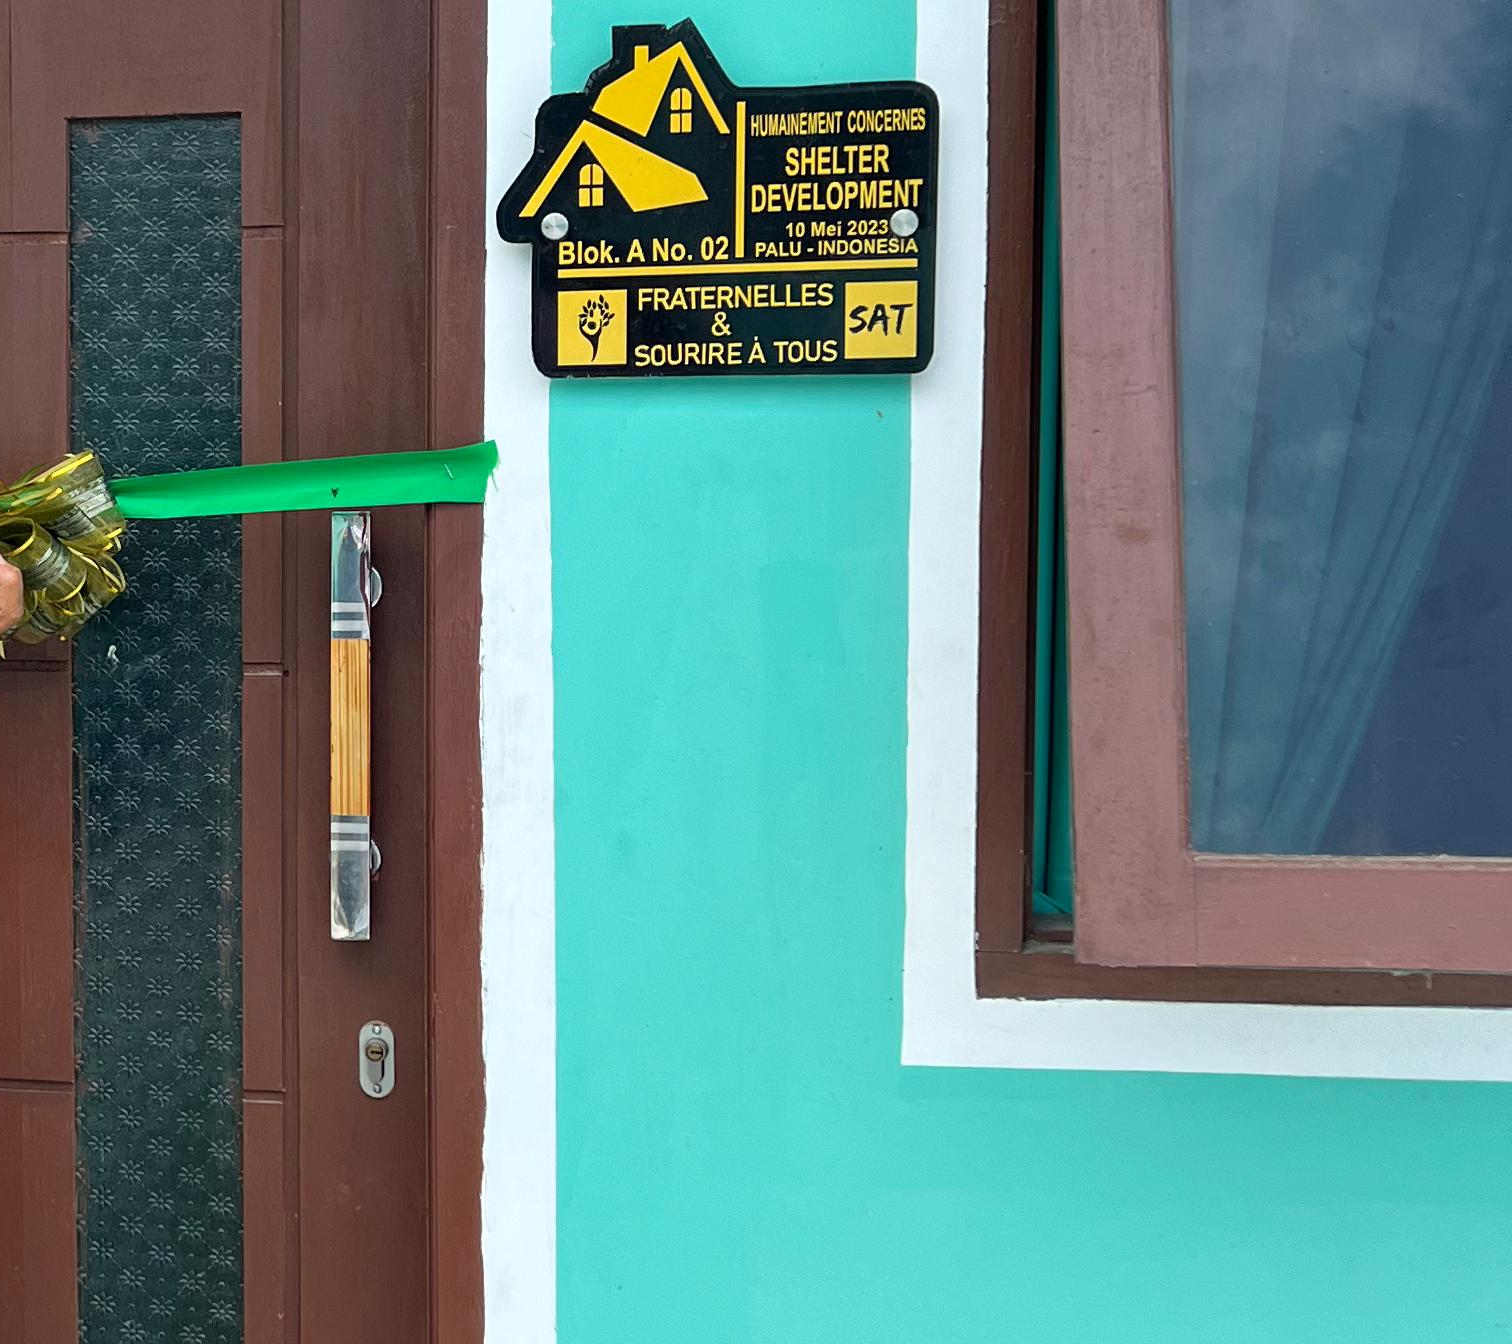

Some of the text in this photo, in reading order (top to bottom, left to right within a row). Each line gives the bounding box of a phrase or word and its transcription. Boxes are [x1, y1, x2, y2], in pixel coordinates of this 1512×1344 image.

[751, 108, 925, 136] HUMAINEMENT CONCERNES
[785, 145, 889, 176] SHELTER
[752, 179, 923, 210] DEVELOPMENT
[786, 219, 888, 237] 10 Mei 2023
[559, 236, 728, 265] Blok. A No. 02
[756, 241, 801, 257] PALU
[818, 238, 918, 255] INDONESIA
[639, 283, 833, 311] FRATERNELLES
[712, 312, 731, 336] &
[849, 303, 913, 336] SAT
[635, 343, 742, 366] SOURIRE
[774, 340, 837, 363] TOUS
